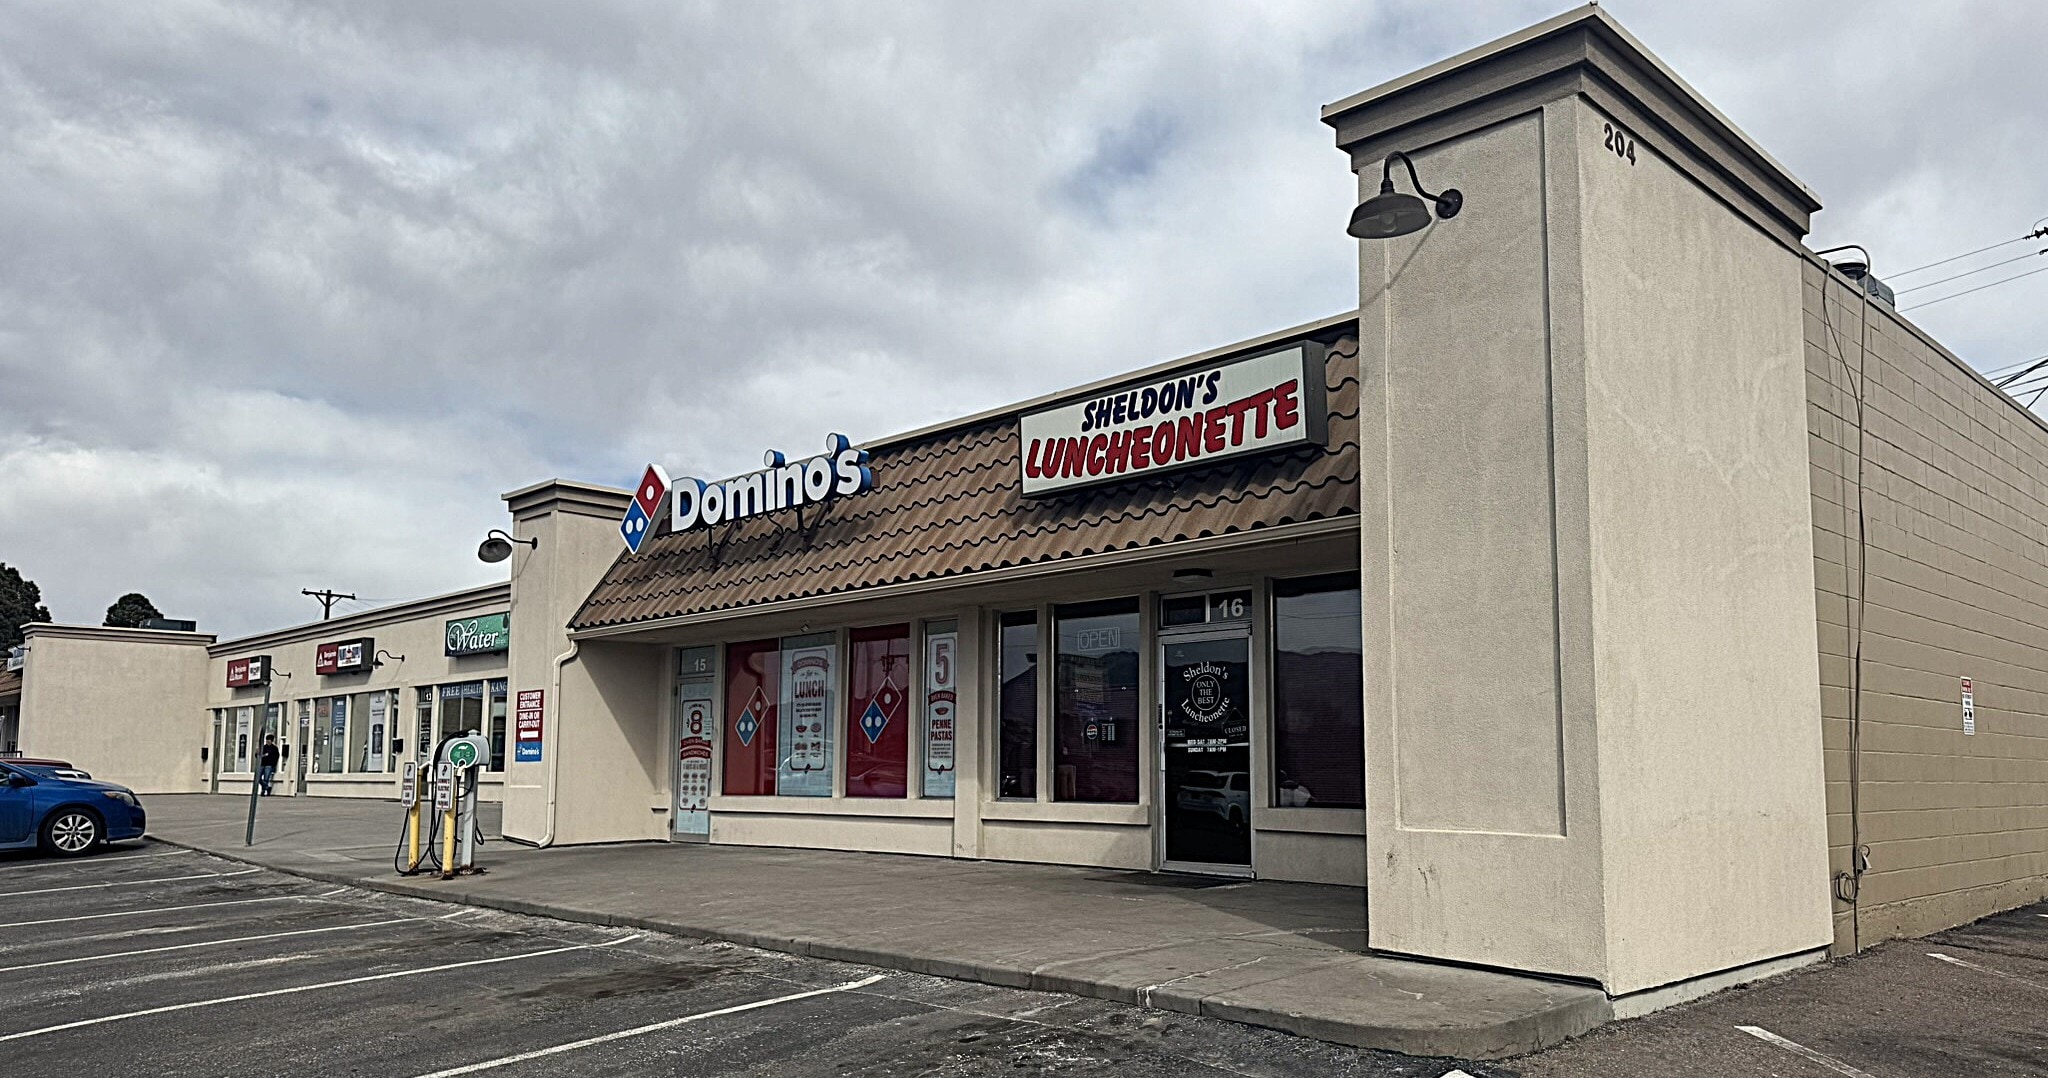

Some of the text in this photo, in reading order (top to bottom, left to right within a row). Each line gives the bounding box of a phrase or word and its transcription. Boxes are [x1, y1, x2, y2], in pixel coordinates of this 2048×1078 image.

[1604, 122, 1636, 166] 204
[1082, 370, 1221, 432] SHELDON'S
[1025, 378, 1299, 478] LUNCHEONETTE
[671, 432, 864, 532] Domino's
[1218, 598, 1244, 618] 16
[447, 620, 499, 651] Water
[1080, 629, 1118, 649] OPEN
[694, 658, 706, 672] 15
[935, 643, 949, 685] 5
[1183, 661, 1229, 682] Sheldon's
[442, 686, 460, 697] FREE
[794, 680, 824, 699] LUNCH
[1196, 680, 1215, 689] ONLY
[519, 691, 541, 701] CUSTOMER
[519, 700, 541, 709] ENTRANCE
[1197, 697, 1215, 705] BEST
[519, 712, 533, 721] DINE-IN
[1181, 697, 1231, 723] Luncheonette
[518, 720, 540, 729] CARRY-OUT
[690, 710, 703, 735] 8
[931, 719, 952, 729] PENNE
[1224, 725, 1247, 735] CLOSED
[930, 730, 953, 741] PASTAS
